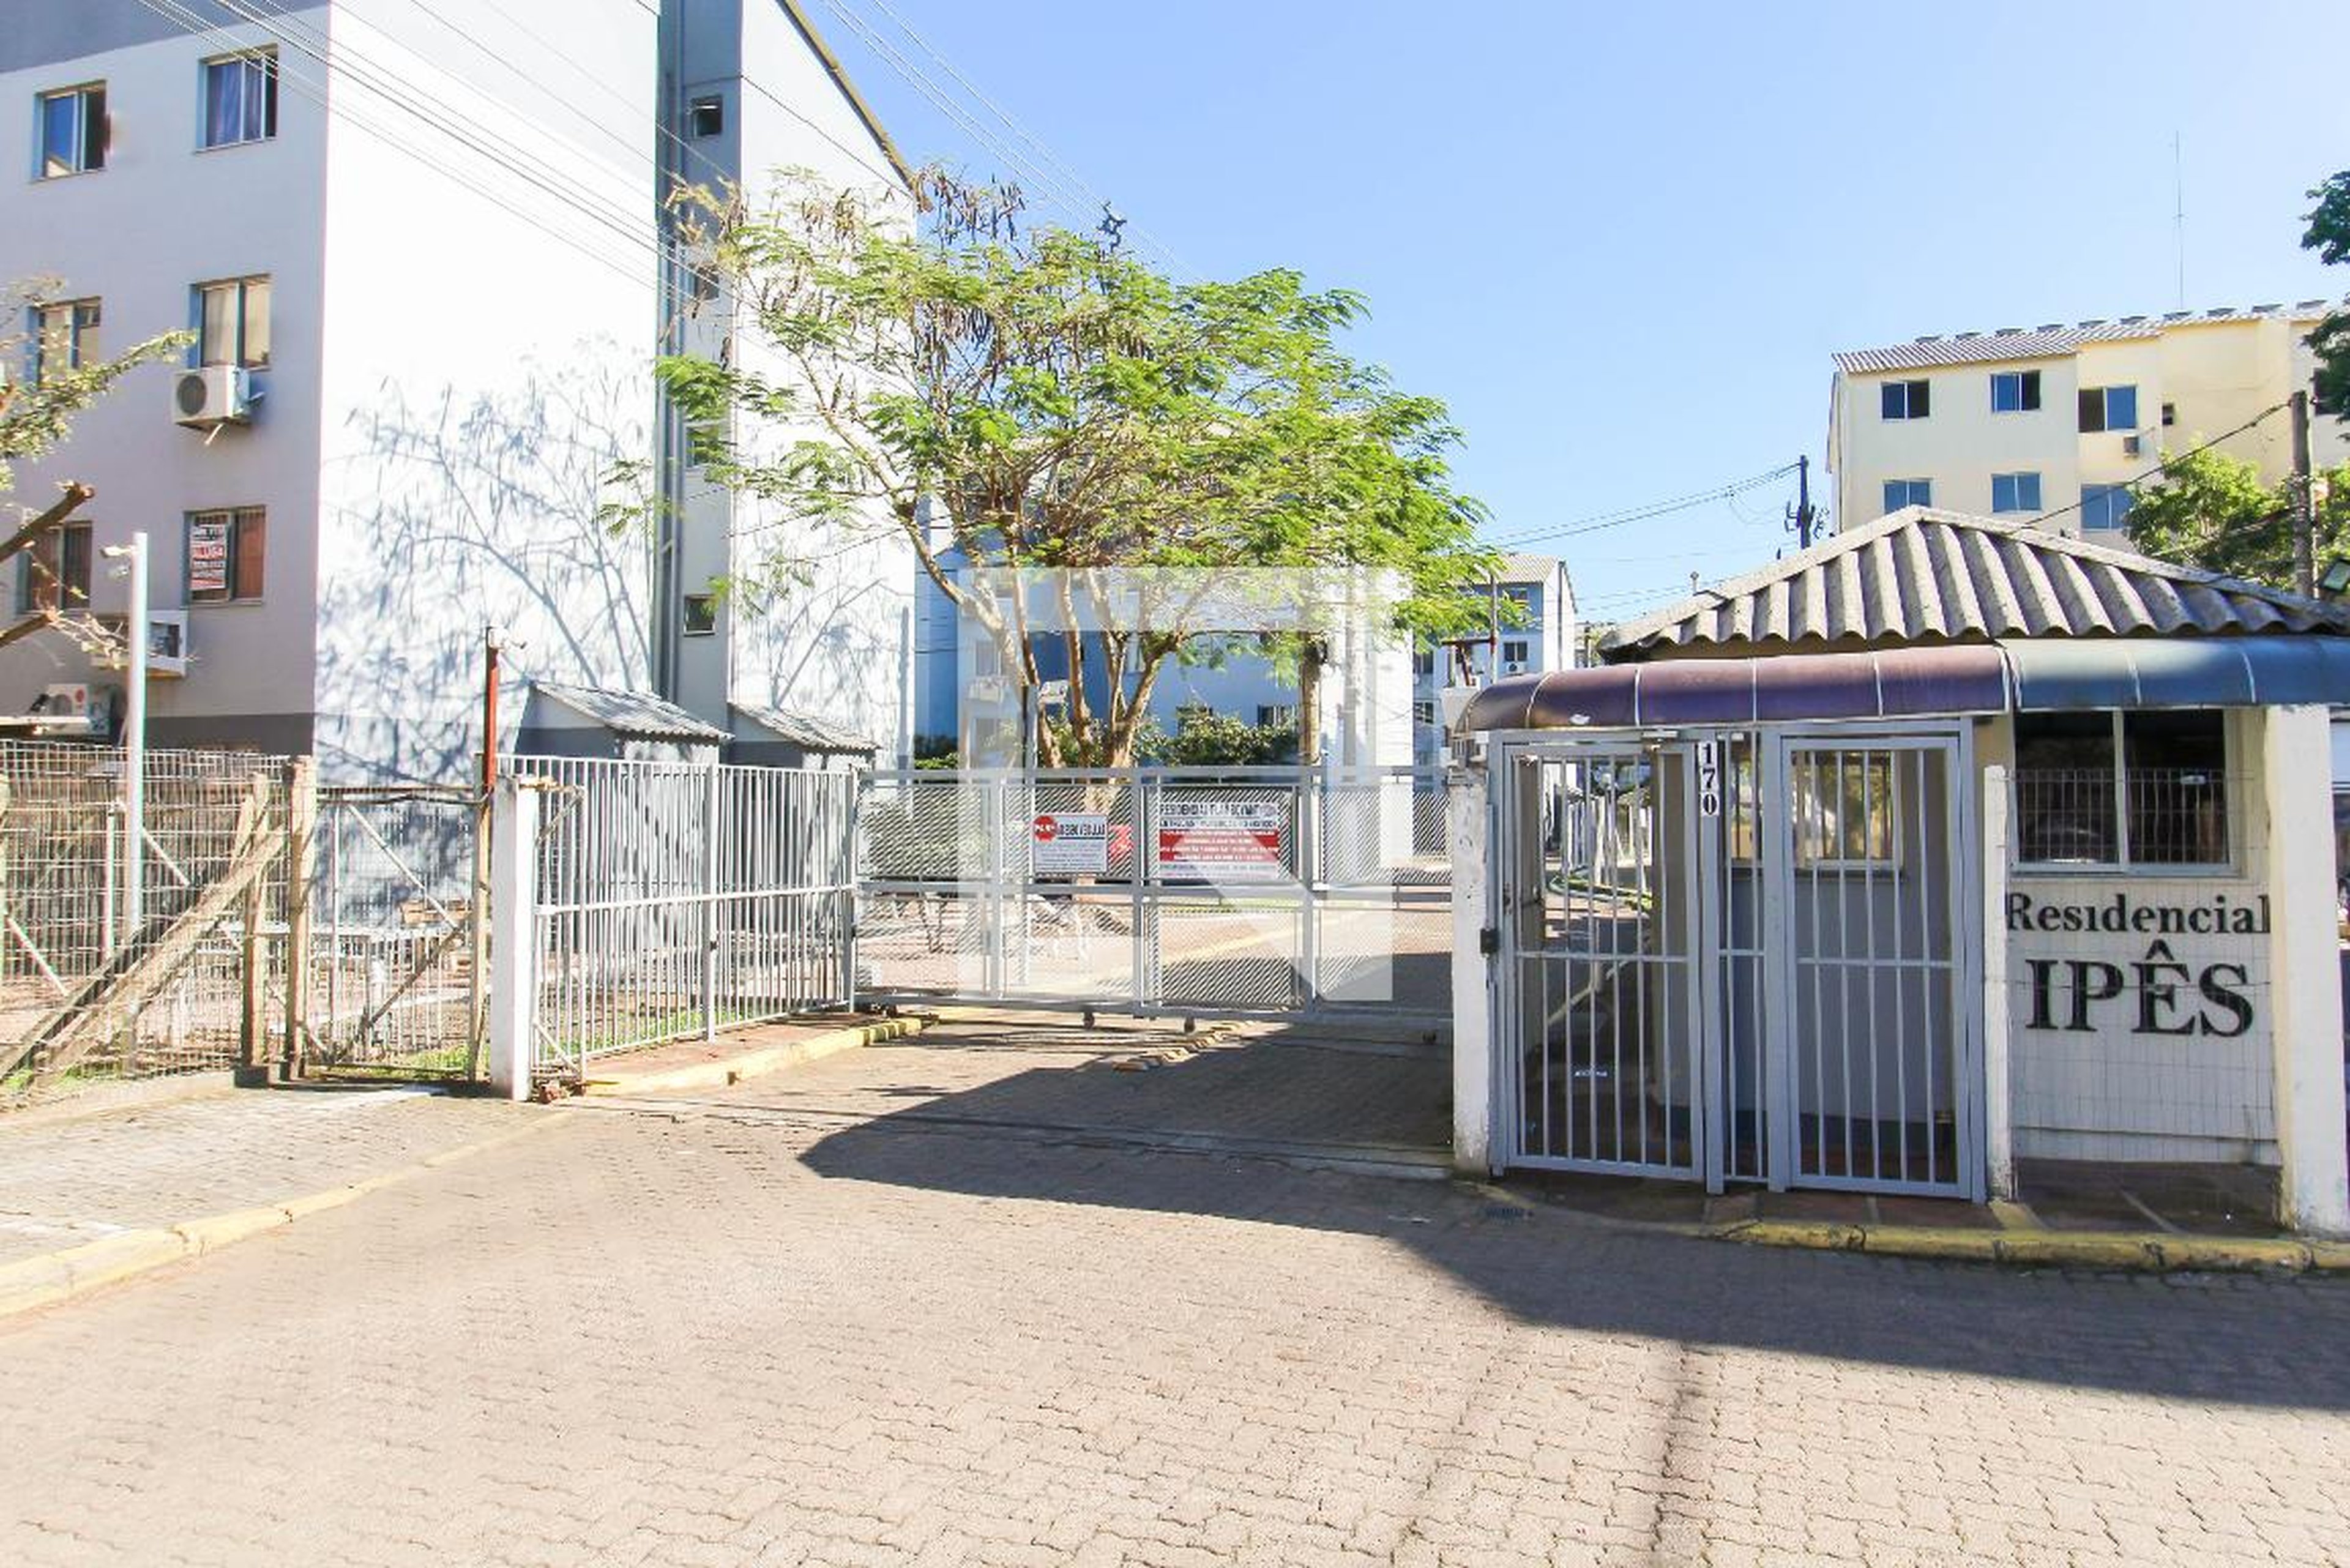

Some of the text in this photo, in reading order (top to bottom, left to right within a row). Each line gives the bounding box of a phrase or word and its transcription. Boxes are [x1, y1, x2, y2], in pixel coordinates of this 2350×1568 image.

[1703, 743, 1717, 815] 170
[2005, 892, 2271, 934] Residencial
[2025, 939, 2254, 1037] IPÊS
